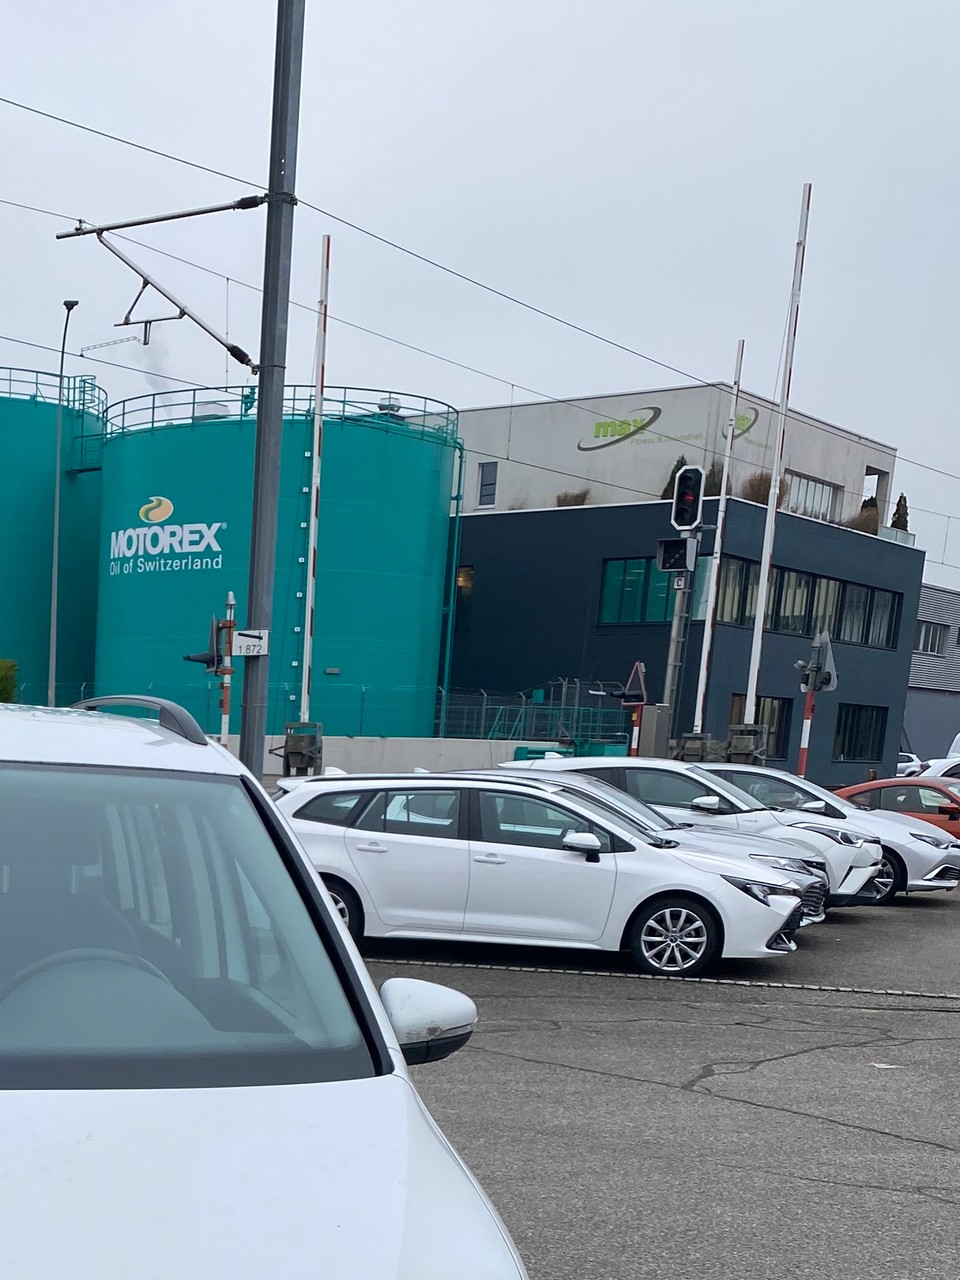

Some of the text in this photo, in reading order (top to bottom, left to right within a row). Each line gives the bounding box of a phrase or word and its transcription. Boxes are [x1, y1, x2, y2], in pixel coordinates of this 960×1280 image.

[110, 522, 222, 559] MOTOREX
[110, 554, 222, 575] Oil of Switzerland
[238, 644, 262, 654] 1.872
